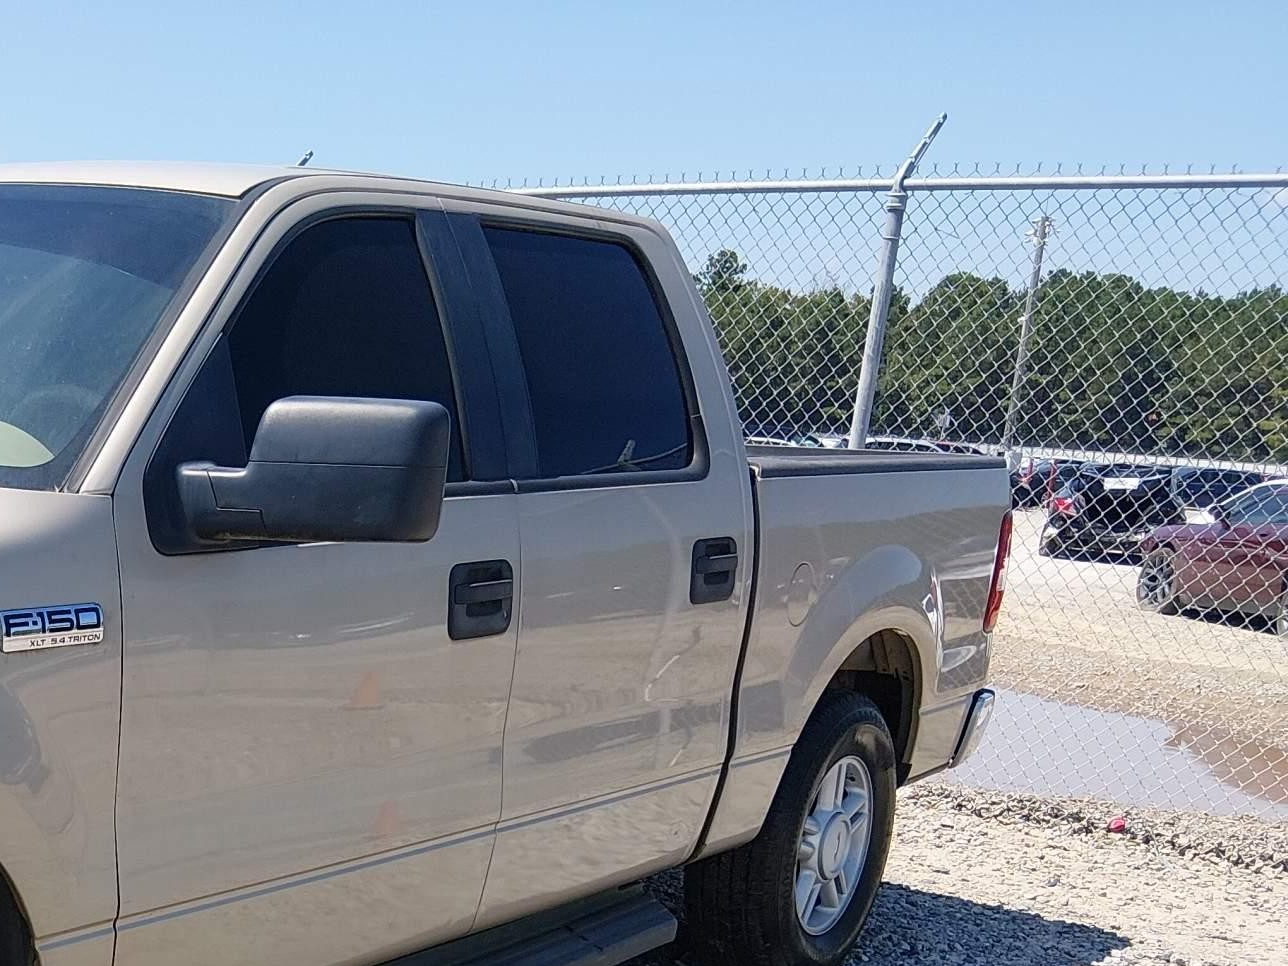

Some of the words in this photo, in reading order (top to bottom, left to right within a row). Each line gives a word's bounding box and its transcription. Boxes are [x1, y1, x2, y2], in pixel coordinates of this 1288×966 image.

[3, 606, 101, 638] F-150
[28, 639, 47, 648] XLT
[67, 633, 101, 644] TRITON
